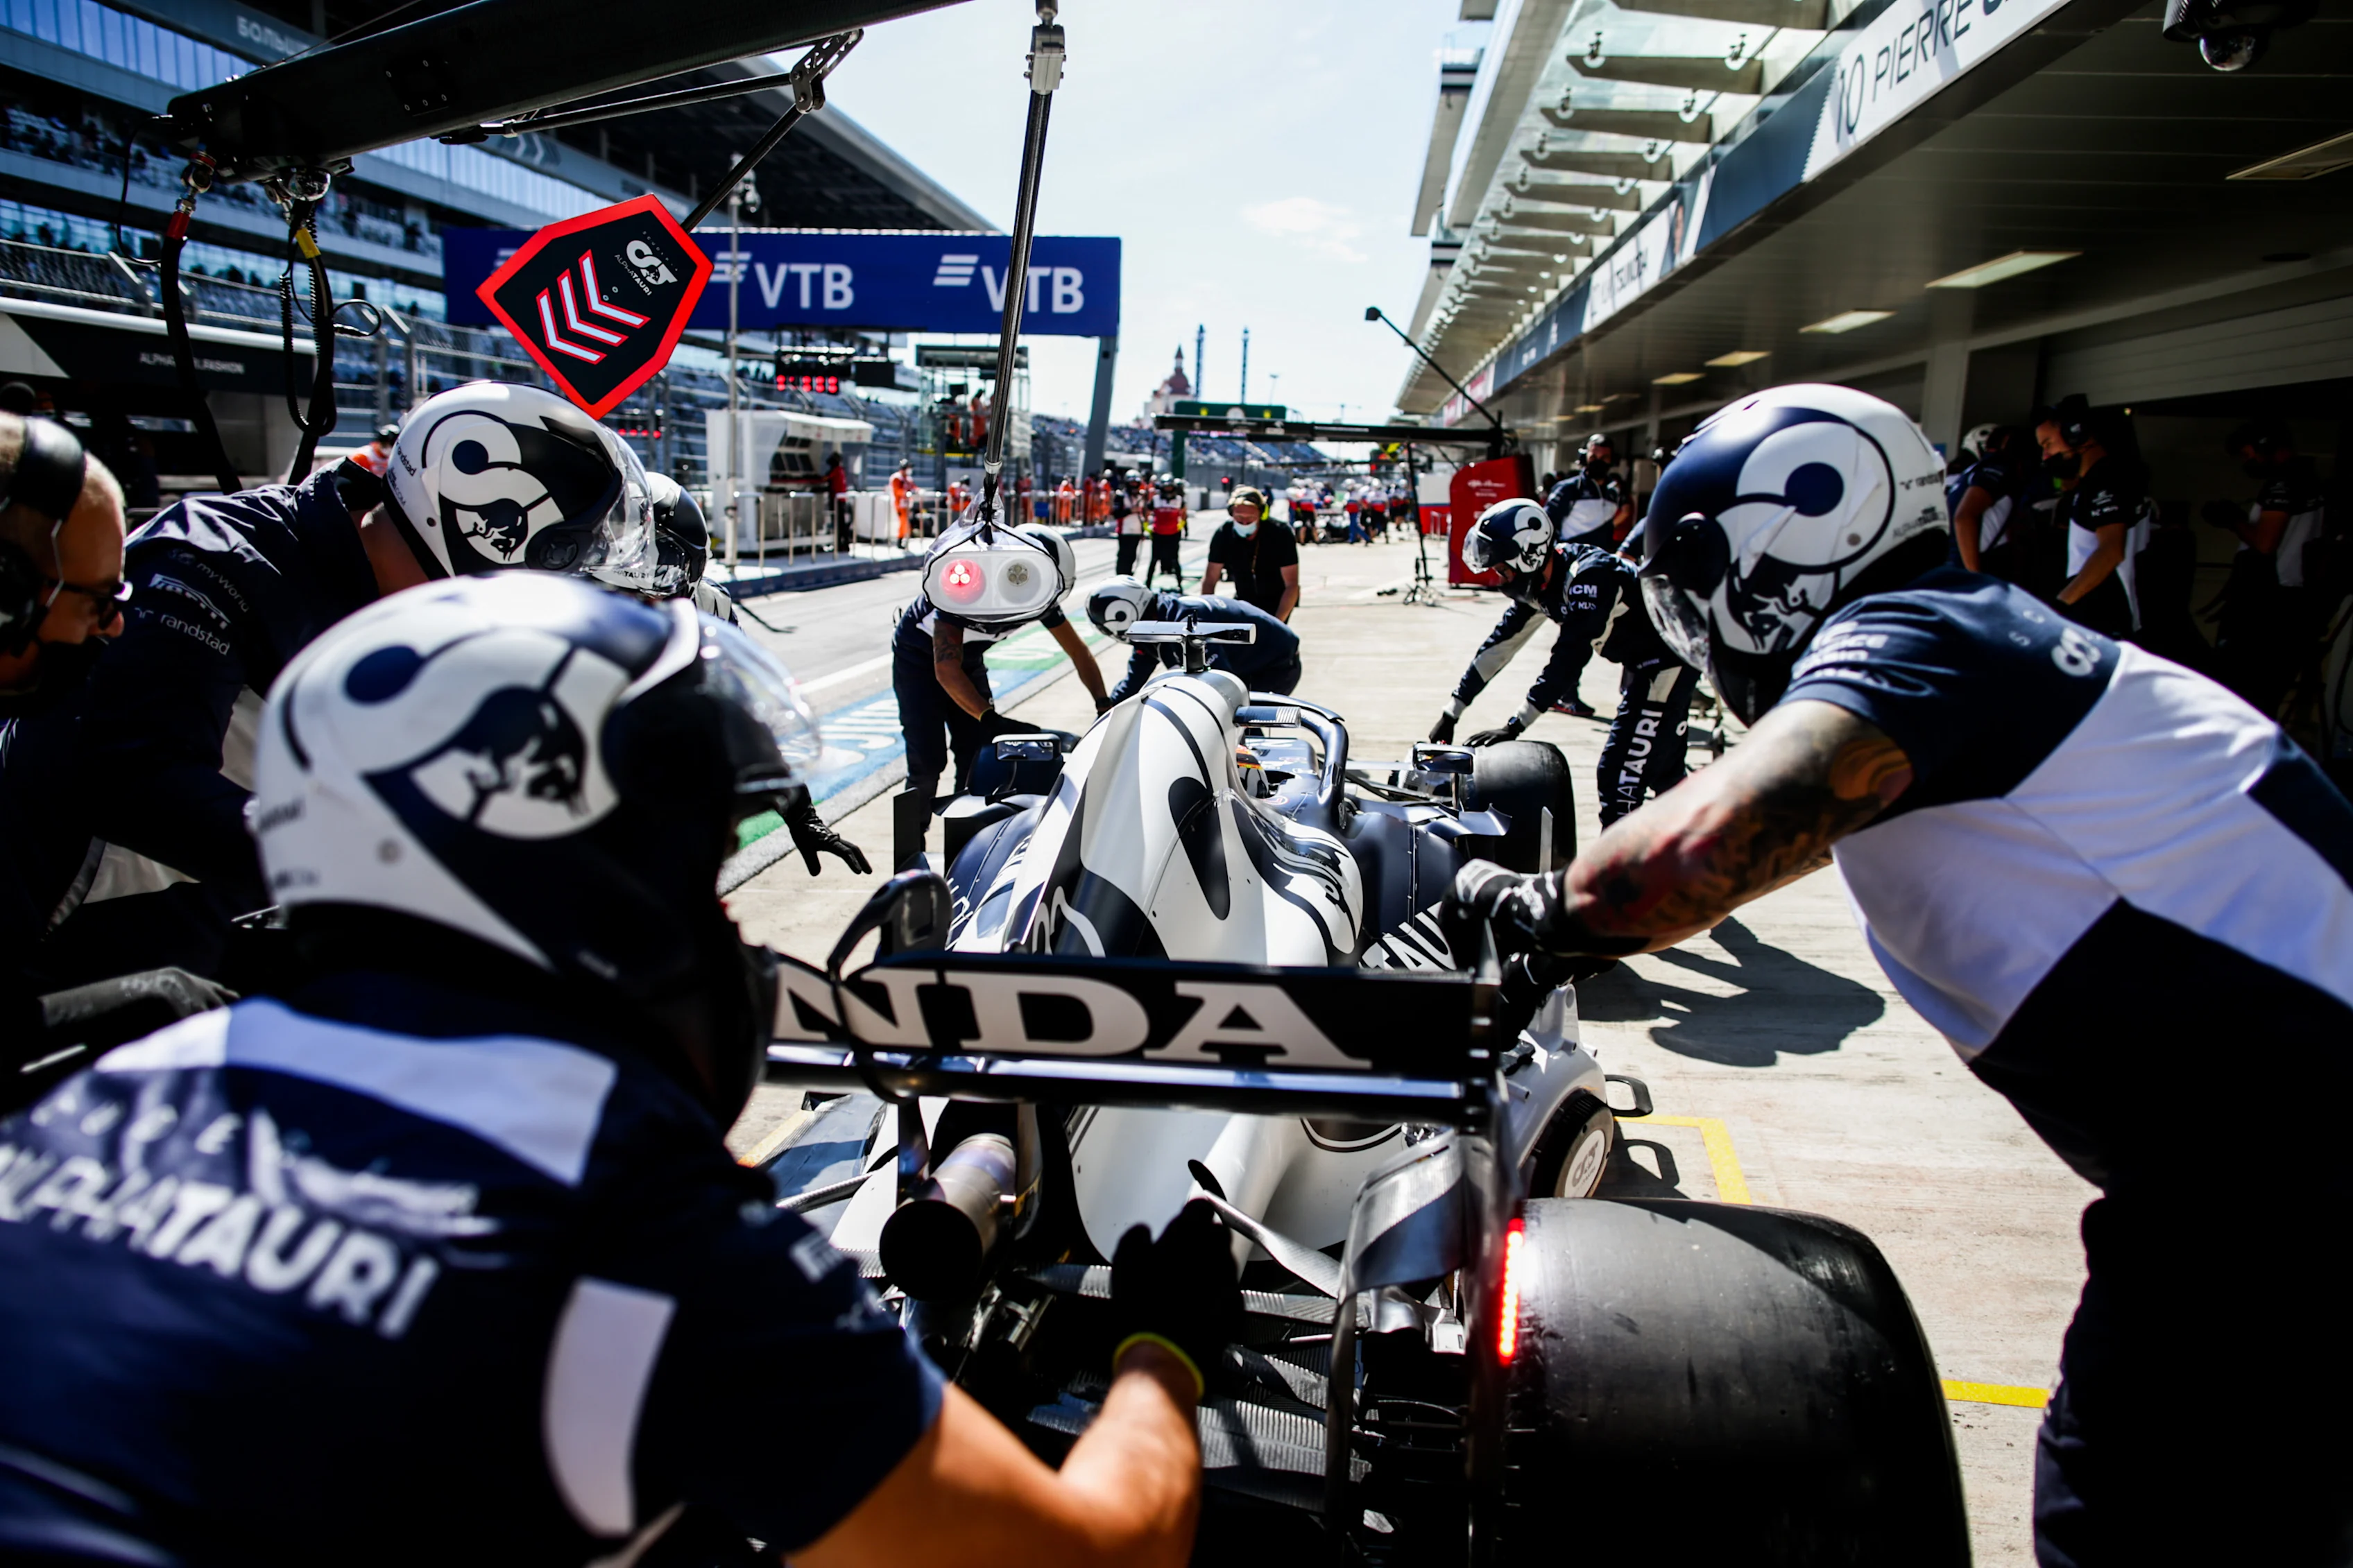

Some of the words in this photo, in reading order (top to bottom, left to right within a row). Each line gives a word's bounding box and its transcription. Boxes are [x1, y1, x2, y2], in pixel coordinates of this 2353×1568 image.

[1836, 53, 1865, 143] 10
[1872, 0, 1972, 103] PIERRE
[615, 254, 652, 296] ALPHATAURI
[754, 264, 855, 310] VTB
[982, 266, 1084, 313] VTB
[160, 614, 230, 655] randstad
